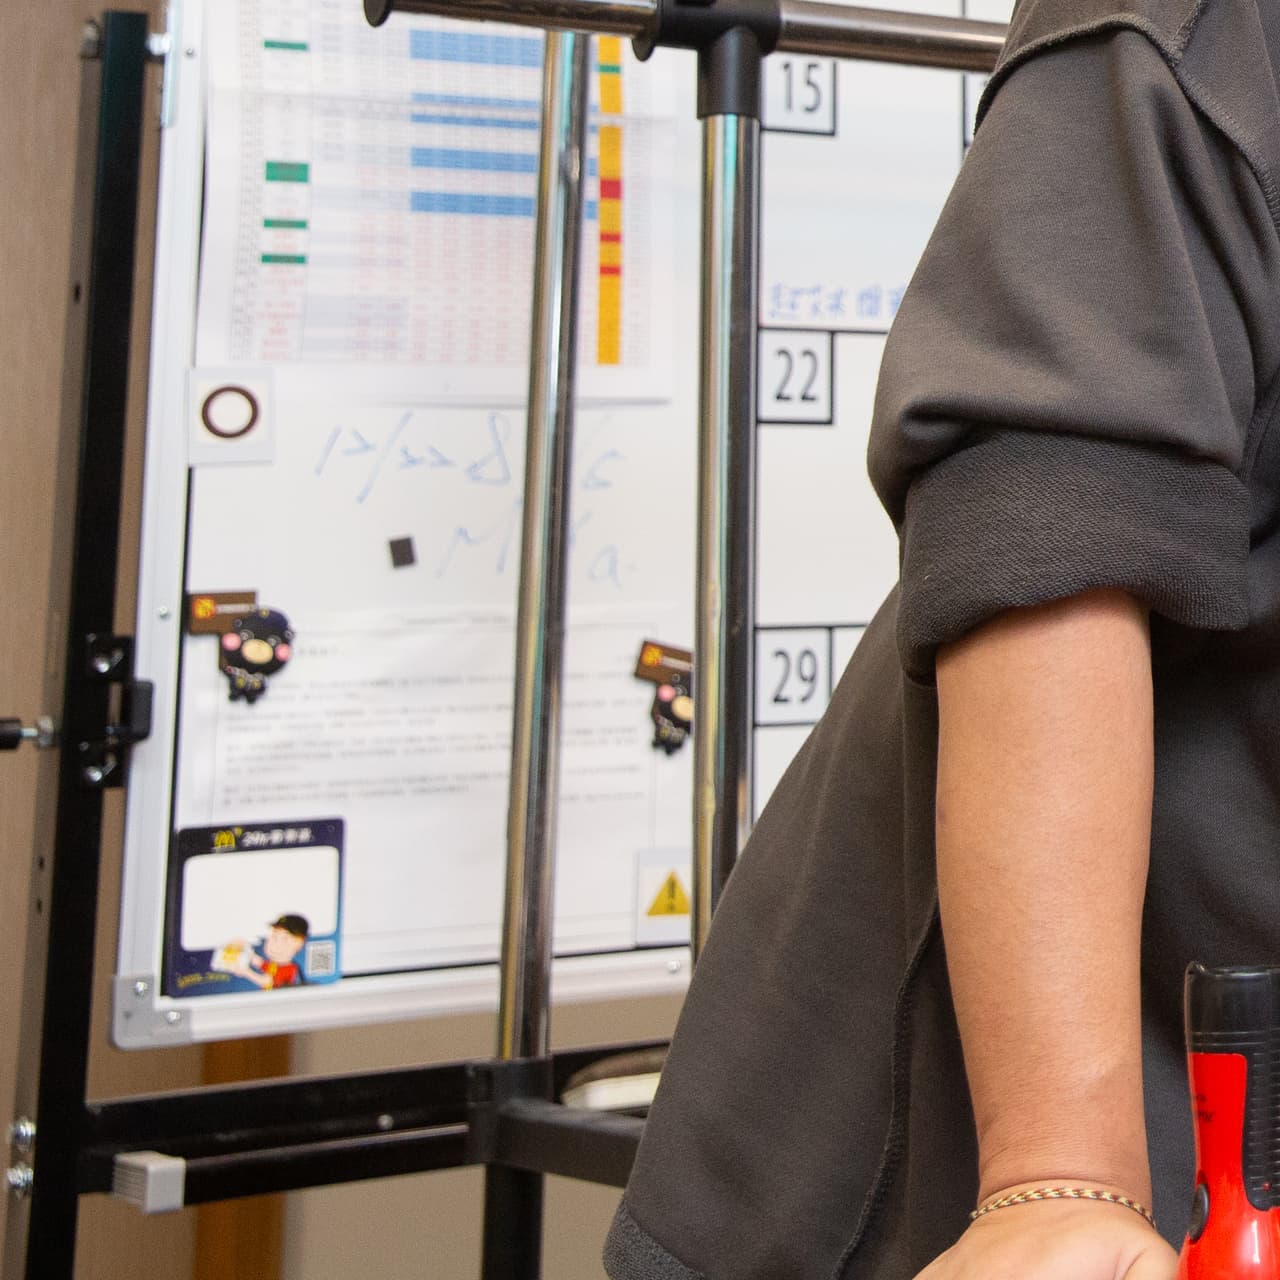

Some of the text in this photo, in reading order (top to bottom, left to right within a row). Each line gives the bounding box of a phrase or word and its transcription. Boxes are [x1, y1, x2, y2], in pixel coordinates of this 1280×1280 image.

[780, 60, 822, 113] 15
[773, 347, 821, 404] 22
[771, 648, 821, 706] 29
